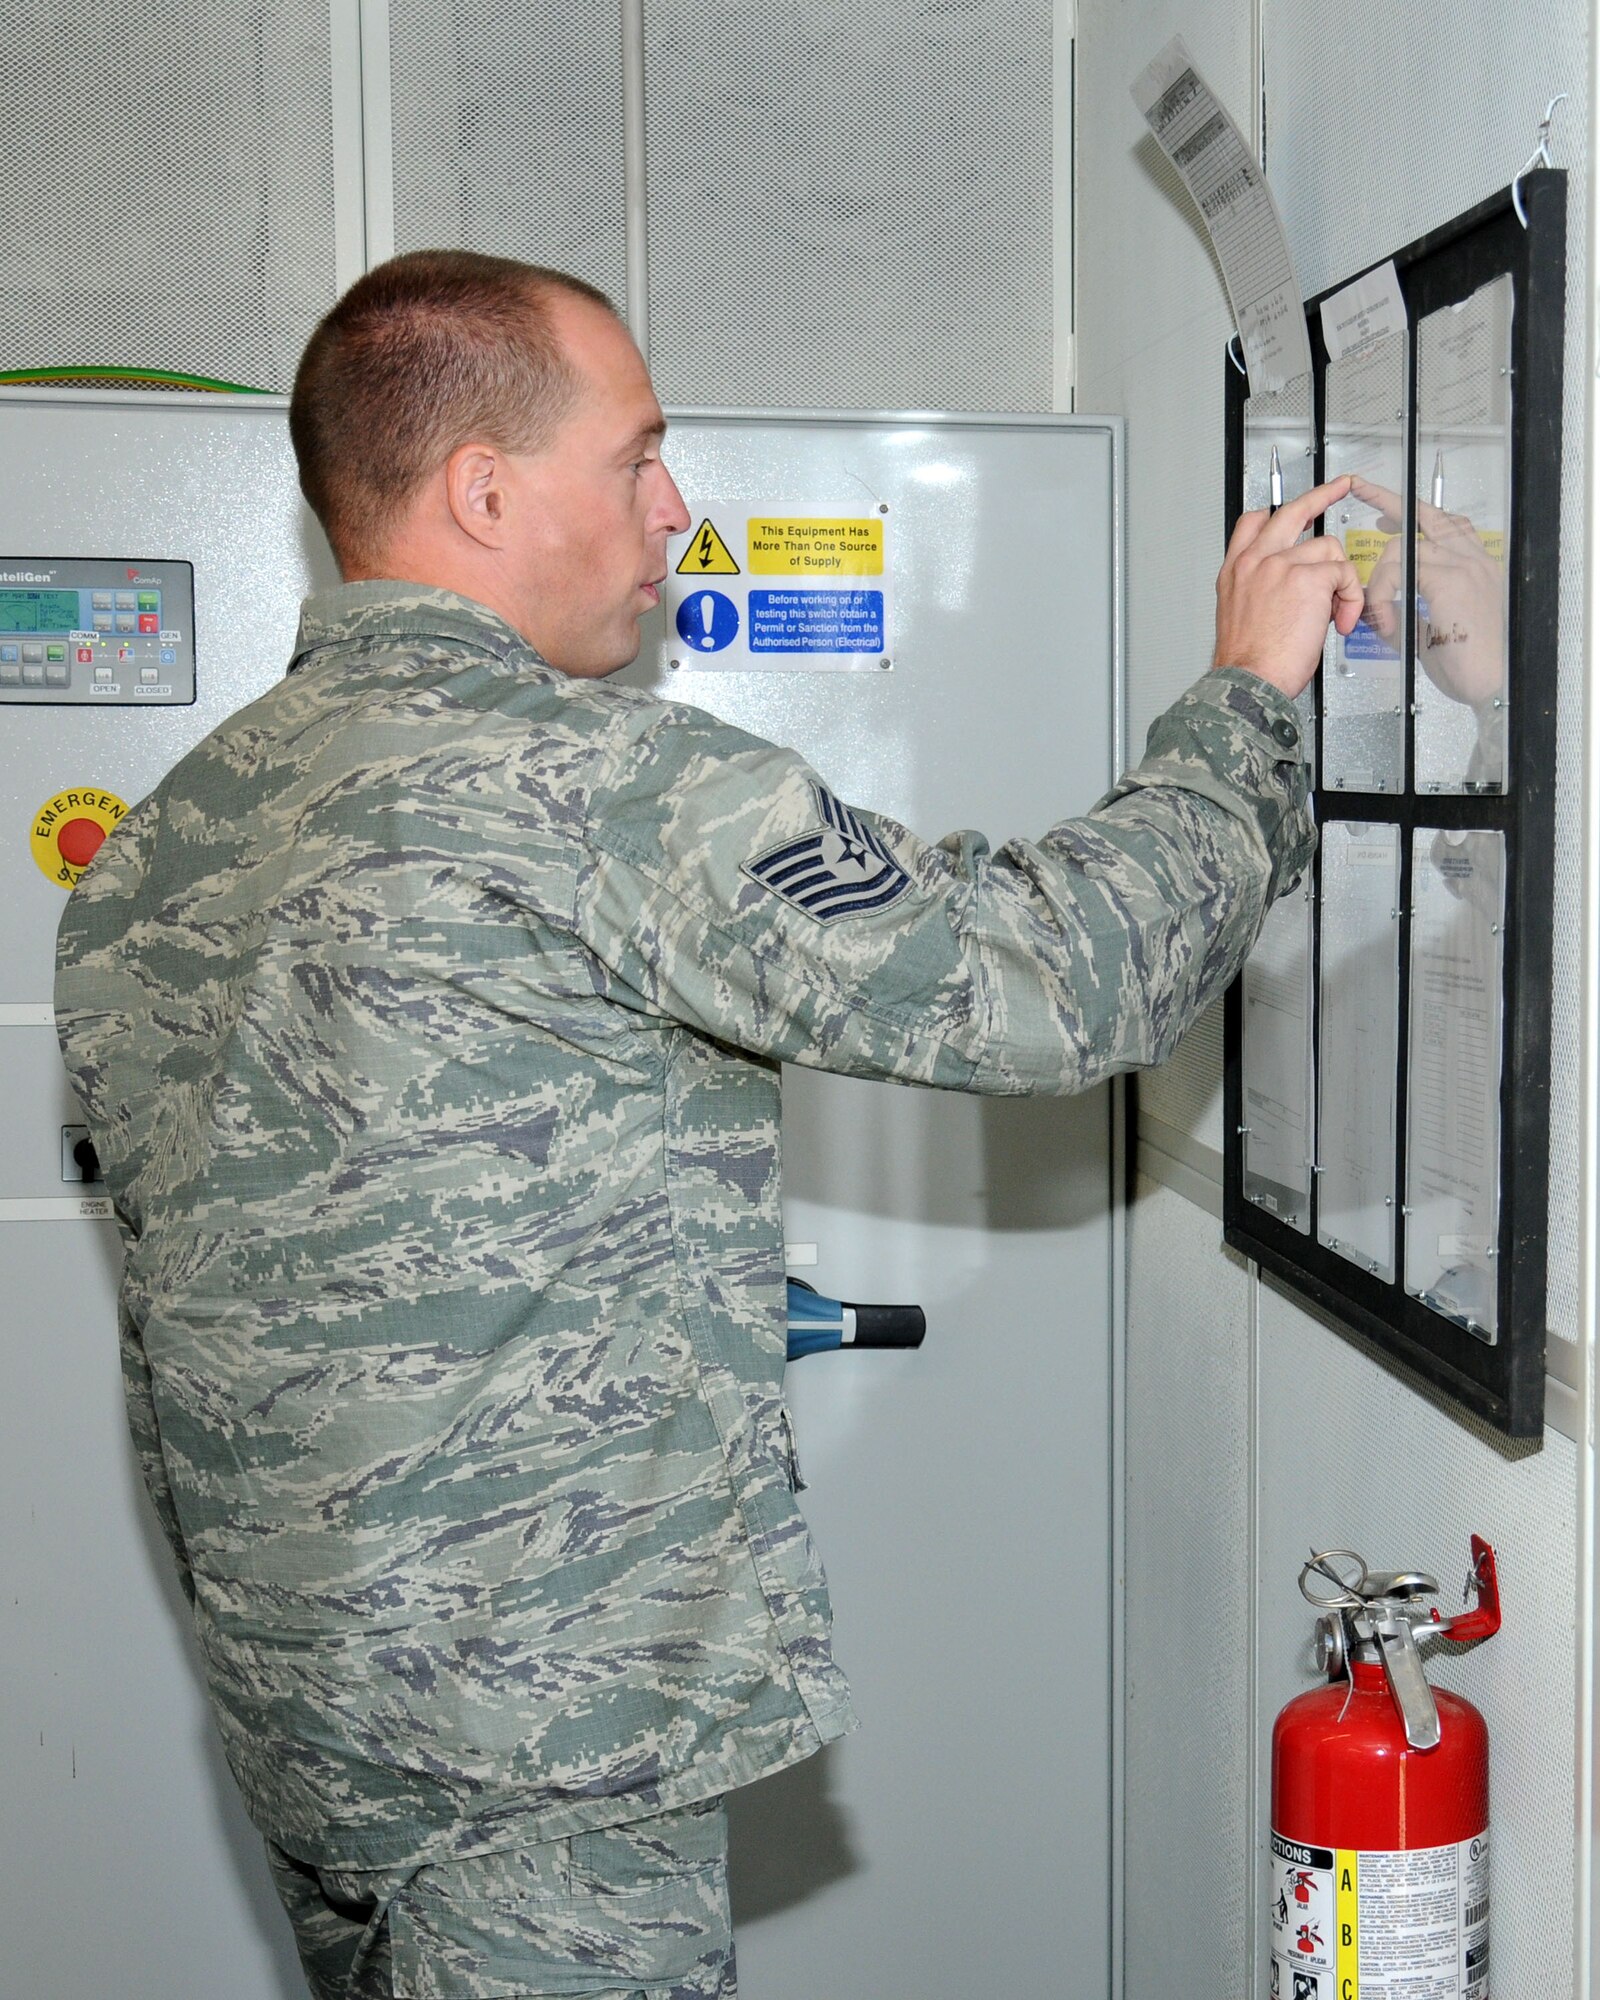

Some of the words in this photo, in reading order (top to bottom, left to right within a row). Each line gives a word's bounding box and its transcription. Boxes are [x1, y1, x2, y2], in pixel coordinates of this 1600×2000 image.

[761, 526, 783, 537] This
[788, 526, 845, 538] Equipment
[849, 527, 869, 537] Has
[753, 541, 780, 551] More
[784, 541, 810, 551] Than
[814, 542, 835, 551] One
[839, 542, 877, 551] Source
[790, 556, 800, 566] of
[804, 556, 841, 568] Supply
[133, 576, 162, 585] ComAp
[768, 595, 798, 605] Before
[801, 595, 836, 607] working
[838, 597, 851, 605] on
[853, 597, 863, 605] or
[756, 609, 787, 621] testing
[789, 609, 806, 619] this
[808, 609, 837, 619] switch
[839, 609, 867, 619] obtain
[754, 623, 784, 633] Permit
[787, 624, 796, 633] or
[798, 623, 838, 633] Sanction
[840, 623, 861, 633] from
[863, 623, 878, 633] the
[71, 631, 98, 640] COMM
[752, 637, 800, 647] Authorised
[802, 638, 833, 647] Person
[835, 637, 881, 648] (Electrical)
[93, 685, 117, 693] OPEN
[1341, 1869, 1352, 1892] A
[1341, 1924, 1352, 1946] B
[1341, 1979, 1353, 2000] C
